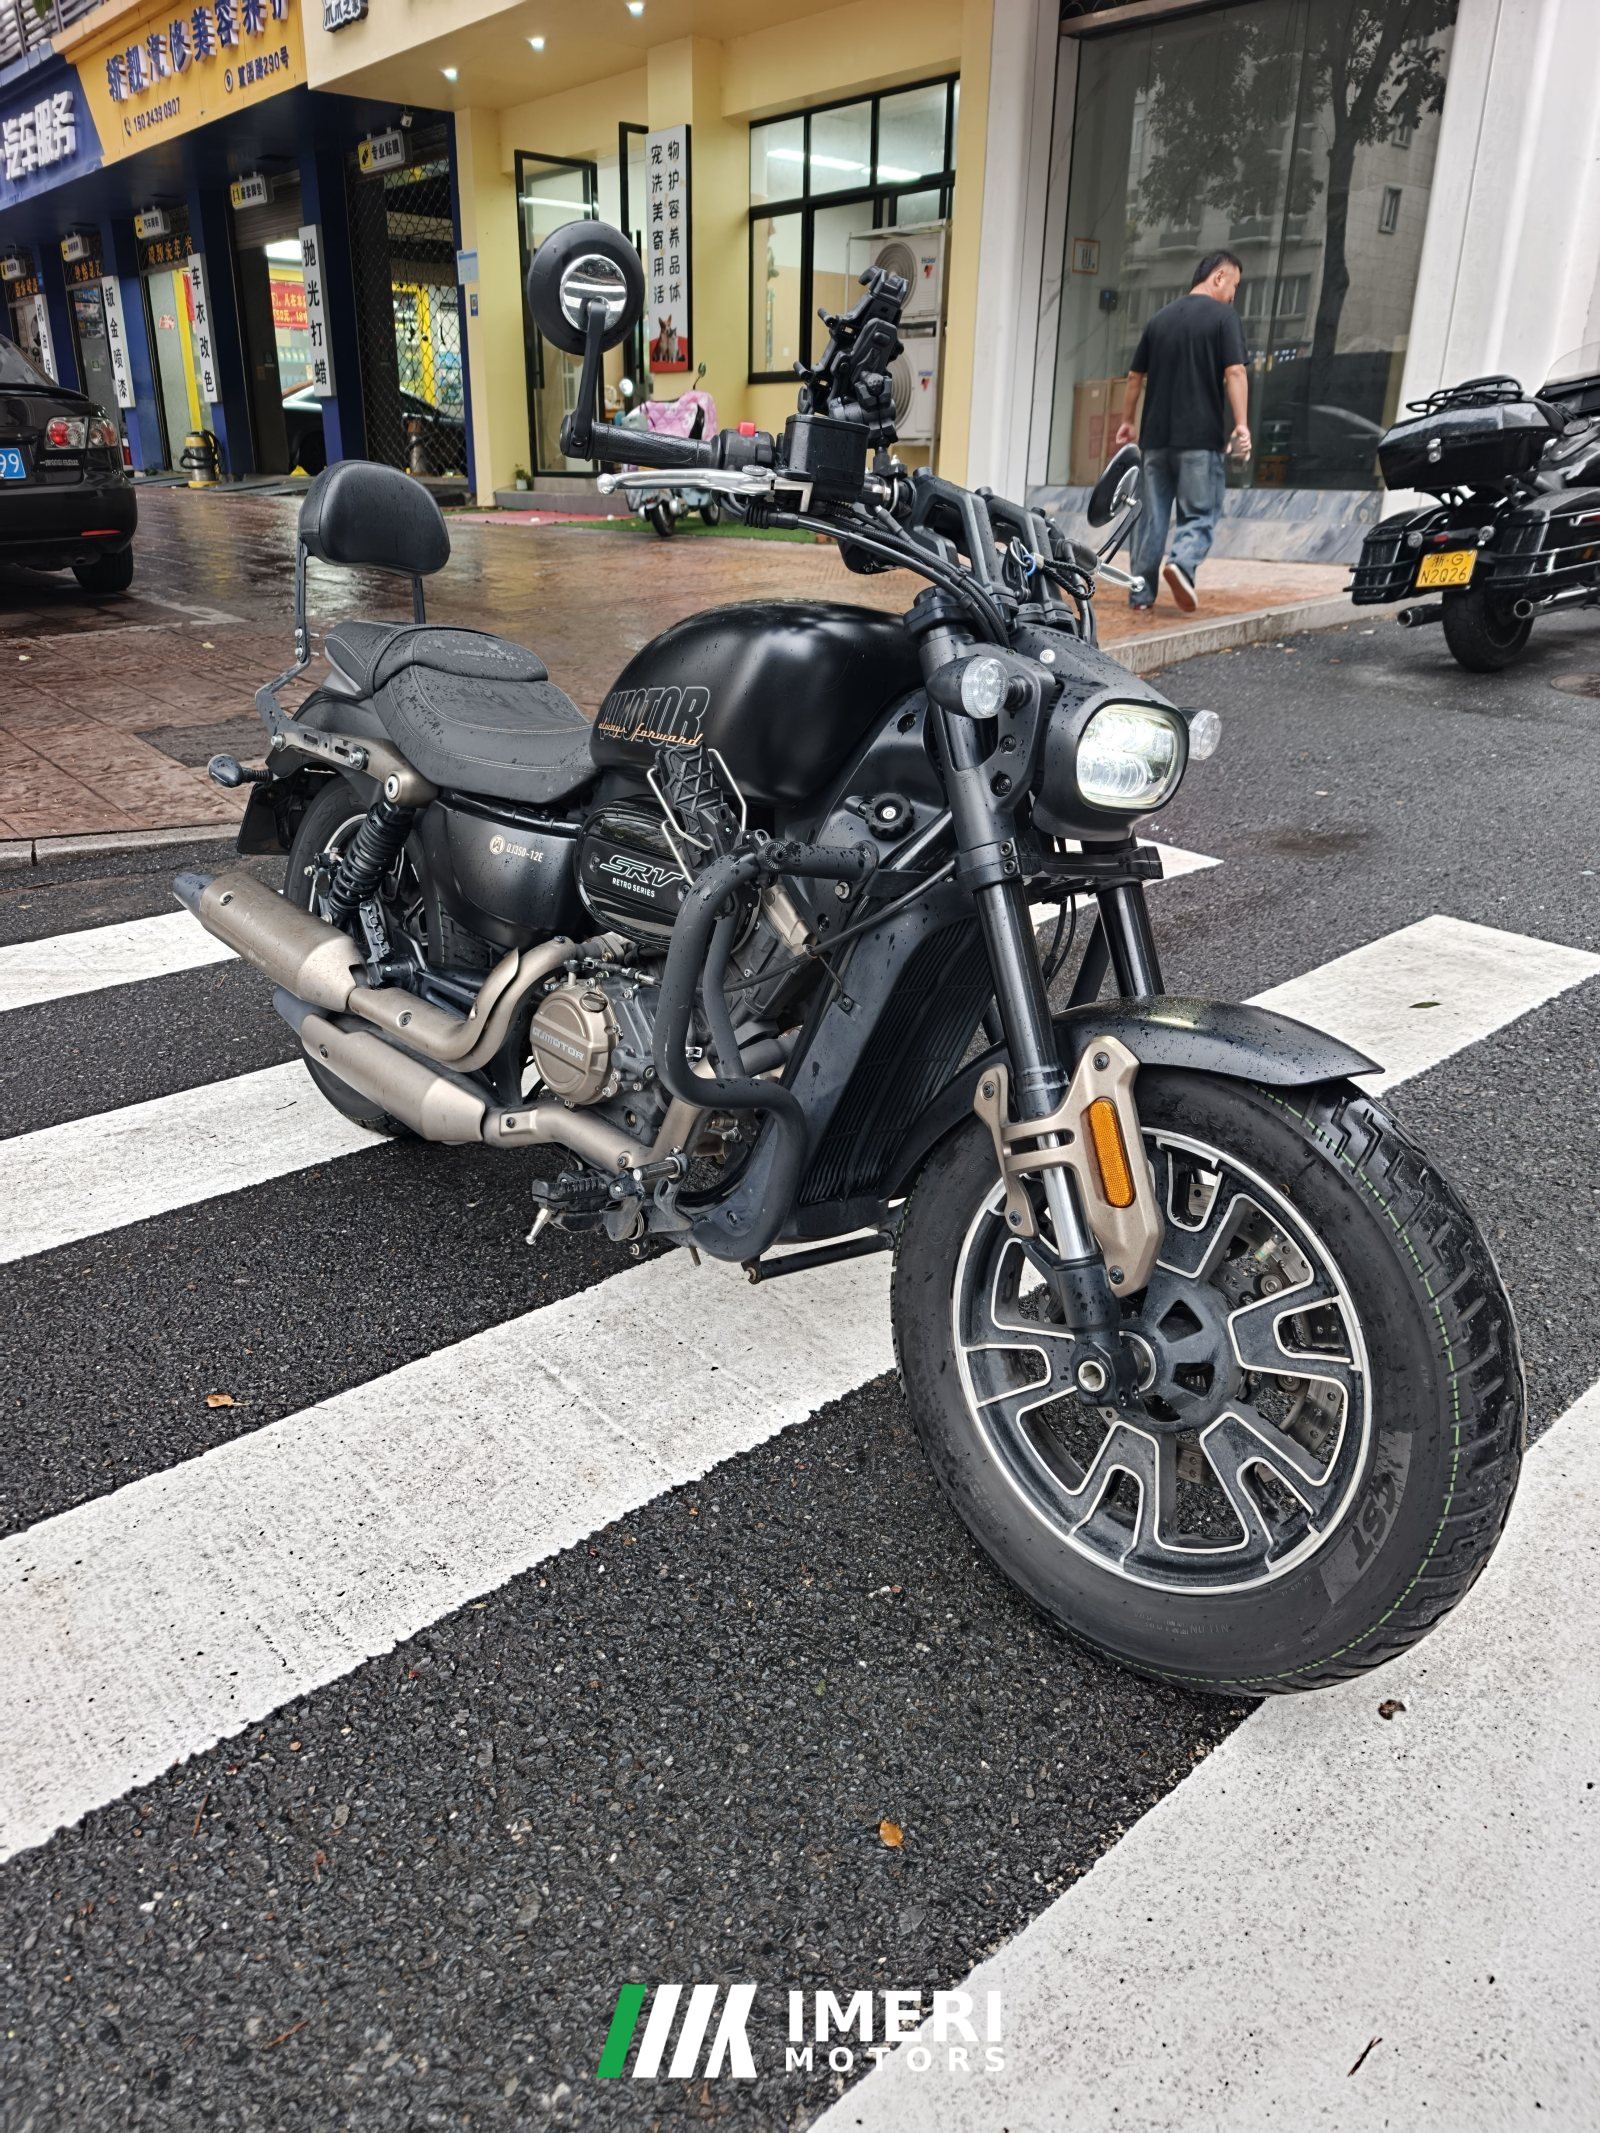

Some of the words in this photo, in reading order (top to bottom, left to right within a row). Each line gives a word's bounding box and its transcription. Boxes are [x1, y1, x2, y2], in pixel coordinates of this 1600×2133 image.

[2, 90, 76, 180] 汽车服务
[651, 139, 680, 165] 宠物
[652, 167, 680, 193] 洗护
[652, 199, 680, 223] 美容
[652, 227, 680, 250] 寄养
[653, 254, 681, 277] 用品
[653, 282, 681, 304] 活体
[302, 239, 328, 386] 抛光打蜡
[191, 265, 215, 393] 车衣改色
[105, 286, 127, 399] 钣金喷漆
[598, 717, 628, 739] always
[631, 722, 704, 746] forward
[599, 854, 686, 888] SRV
[612, 877, 632, 890] RETRO
[632, 884, 655, 898] SERIES
